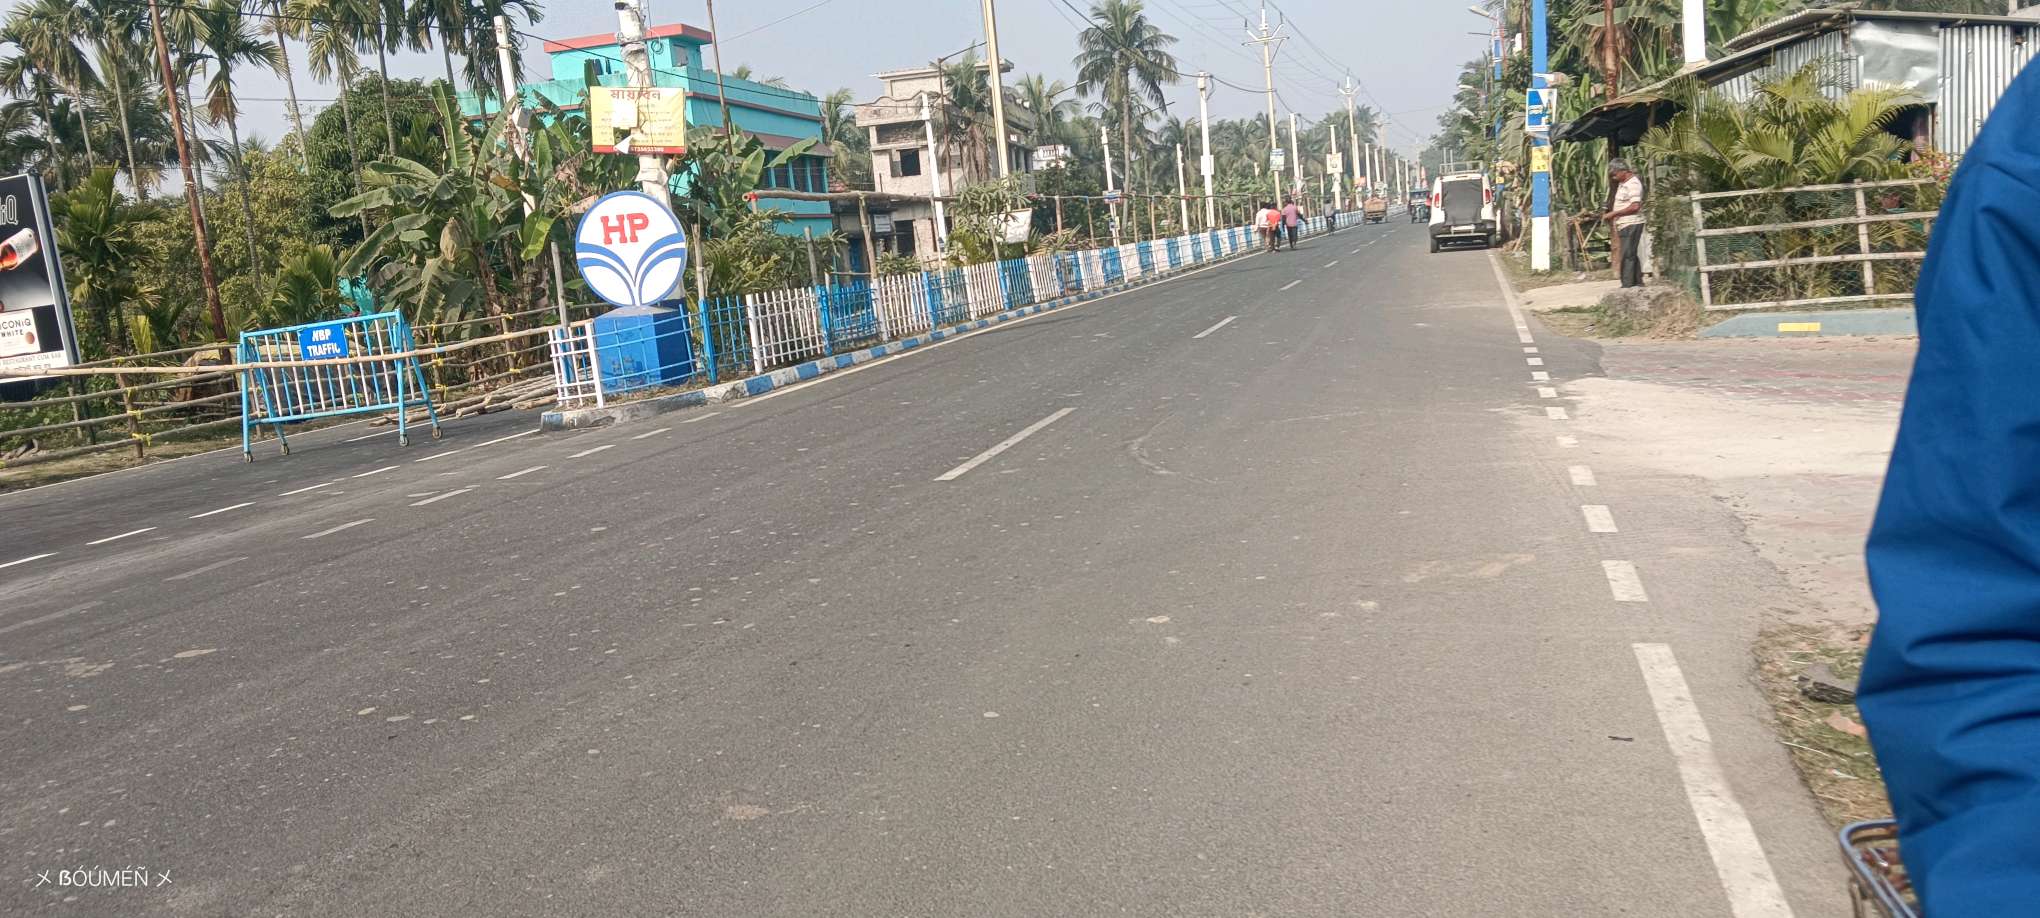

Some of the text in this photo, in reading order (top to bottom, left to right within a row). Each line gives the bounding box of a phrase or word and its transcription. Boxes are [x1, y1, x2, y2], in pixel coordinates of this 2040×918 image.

[600, 212, 649, 245] HP
[312, 328, 332, 342] NBP
[307, 342, 341, 357] TRAFFIC
